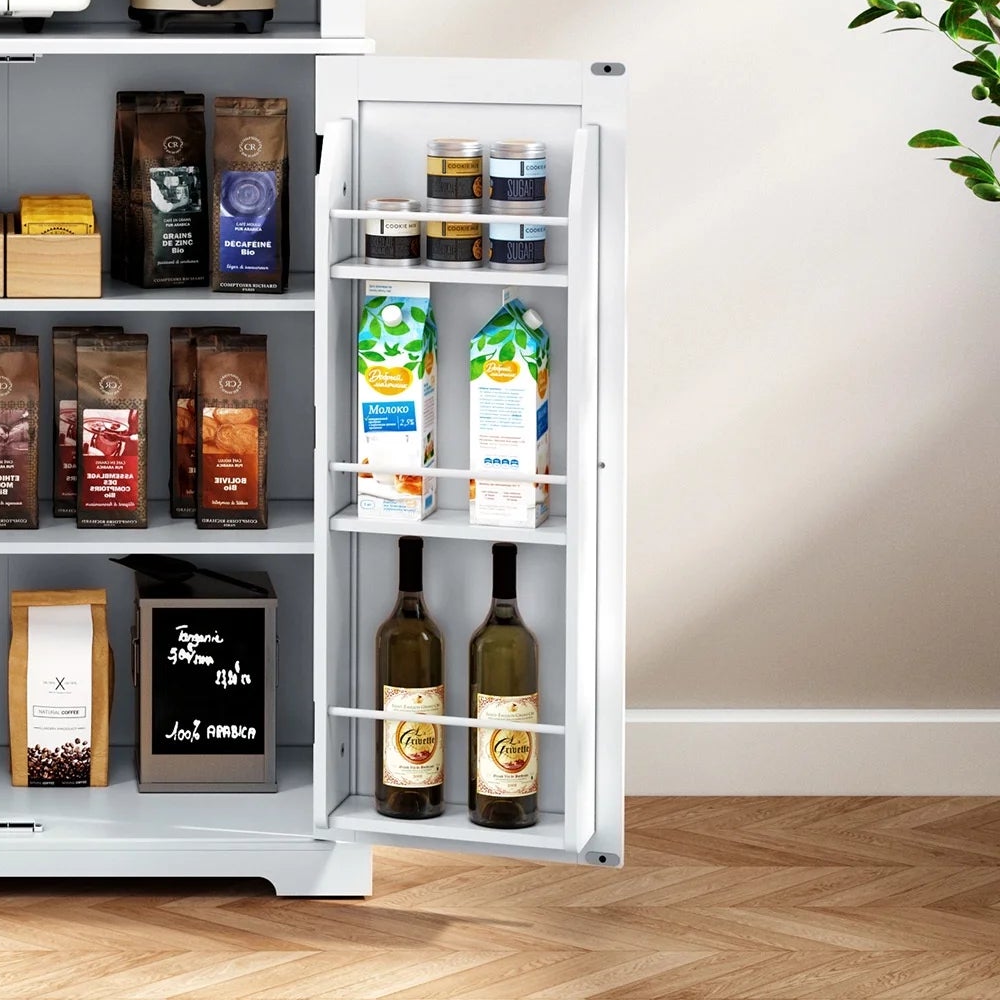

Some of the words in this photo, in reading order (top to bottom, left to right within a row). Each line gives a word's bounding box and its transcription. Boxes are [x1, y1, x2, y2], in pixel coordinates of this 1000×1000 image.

[507, 179, 533, 198] SUGAR
[506, 242, 533, 261] SUGAR
[368, 404, 409, 415] Молоко
[165, 719, 201, 742] 100%
[207, 725, 257, 739] ARABICA
